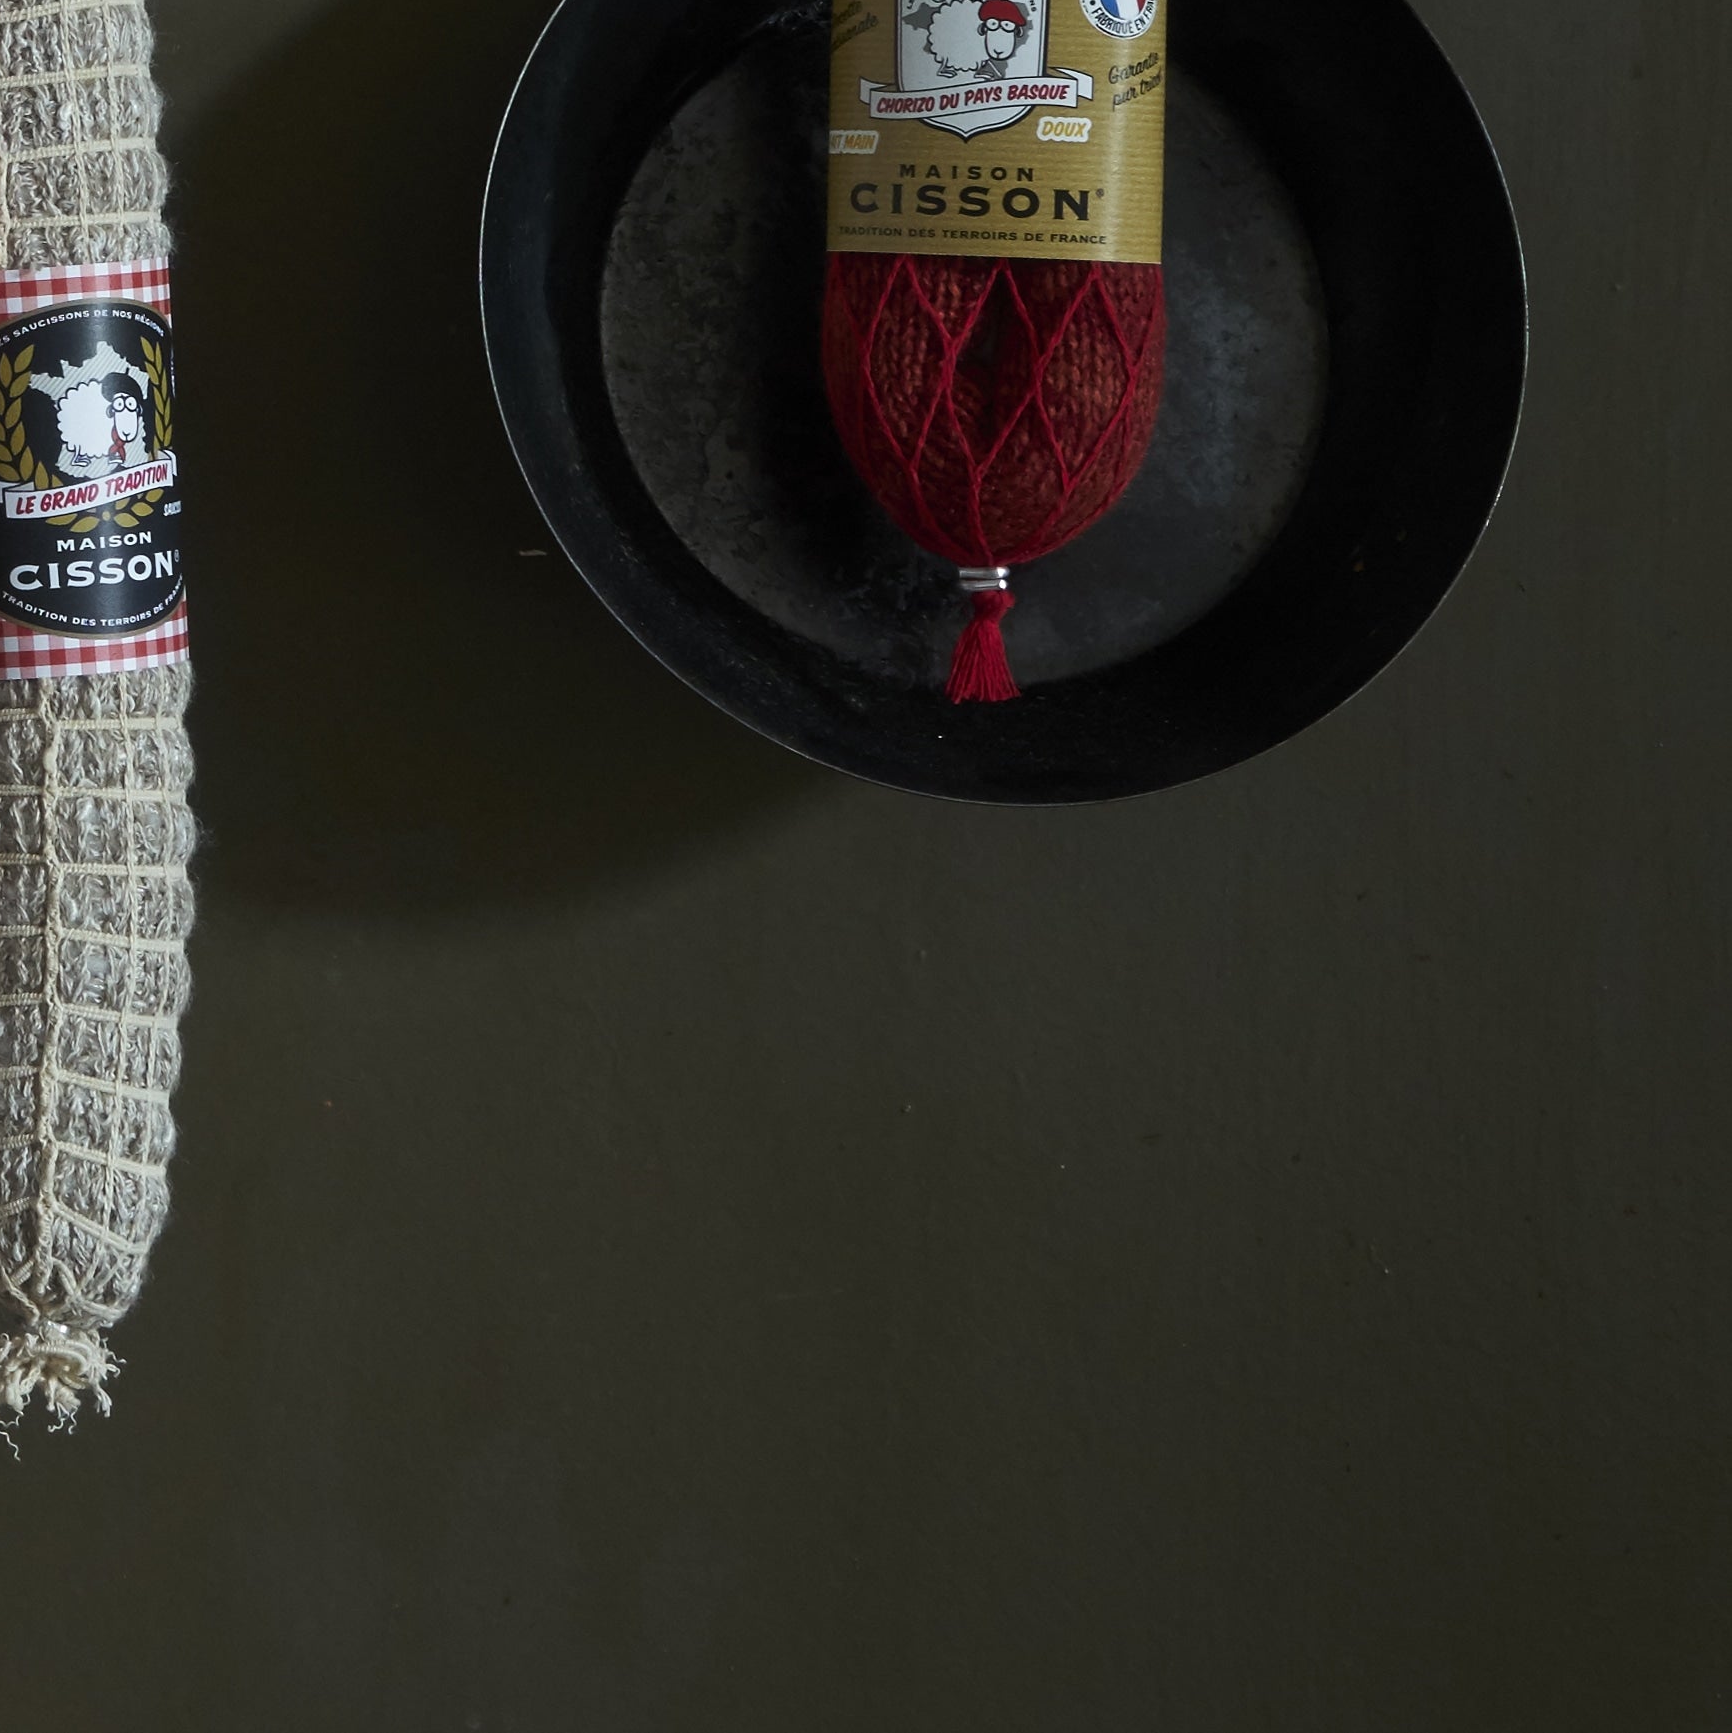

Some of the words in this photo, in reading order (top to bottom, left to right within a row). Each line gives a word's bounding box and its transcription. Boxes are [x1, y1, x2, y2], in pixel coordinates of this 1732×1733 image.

[1134, 16, 1146, 30] EN
[876, 96, 935, 113] CHORIZO
[939, 93, 959, 110] DU
[964, 86, 1002, 106] PAYS
[1007, 84, 1070, 100] BASQUE
[1041, 121, 1086, 137] DOUX
[898, 163, 1034, 182] MAISON
[839, 226, 902, 237] TRADITION
[908, 228, 936, 238] DES
[942, 229, 1018, 241] TERROIRS
[1023, 233, 1045, 243] DE
[1050, 233, 1107, 245] FRANCE
[12, 310, 90, 337] SAUCISSONS
[94, 309, 108, 317] DE
[112, 309, 132, 319] NOS
[15, 496, 36, 515] LE
[40, 484, 99, 513] GRAND
[105, 463, 169, 498] TRADITION
[57, 531, 152, 552] MAISON
[2, 591, 68, 623] TRADITION
[72, 617, 97, 627] DES
[100, 610, 152, 627] TERROIRS
[153, 602, 164, 615] DE
